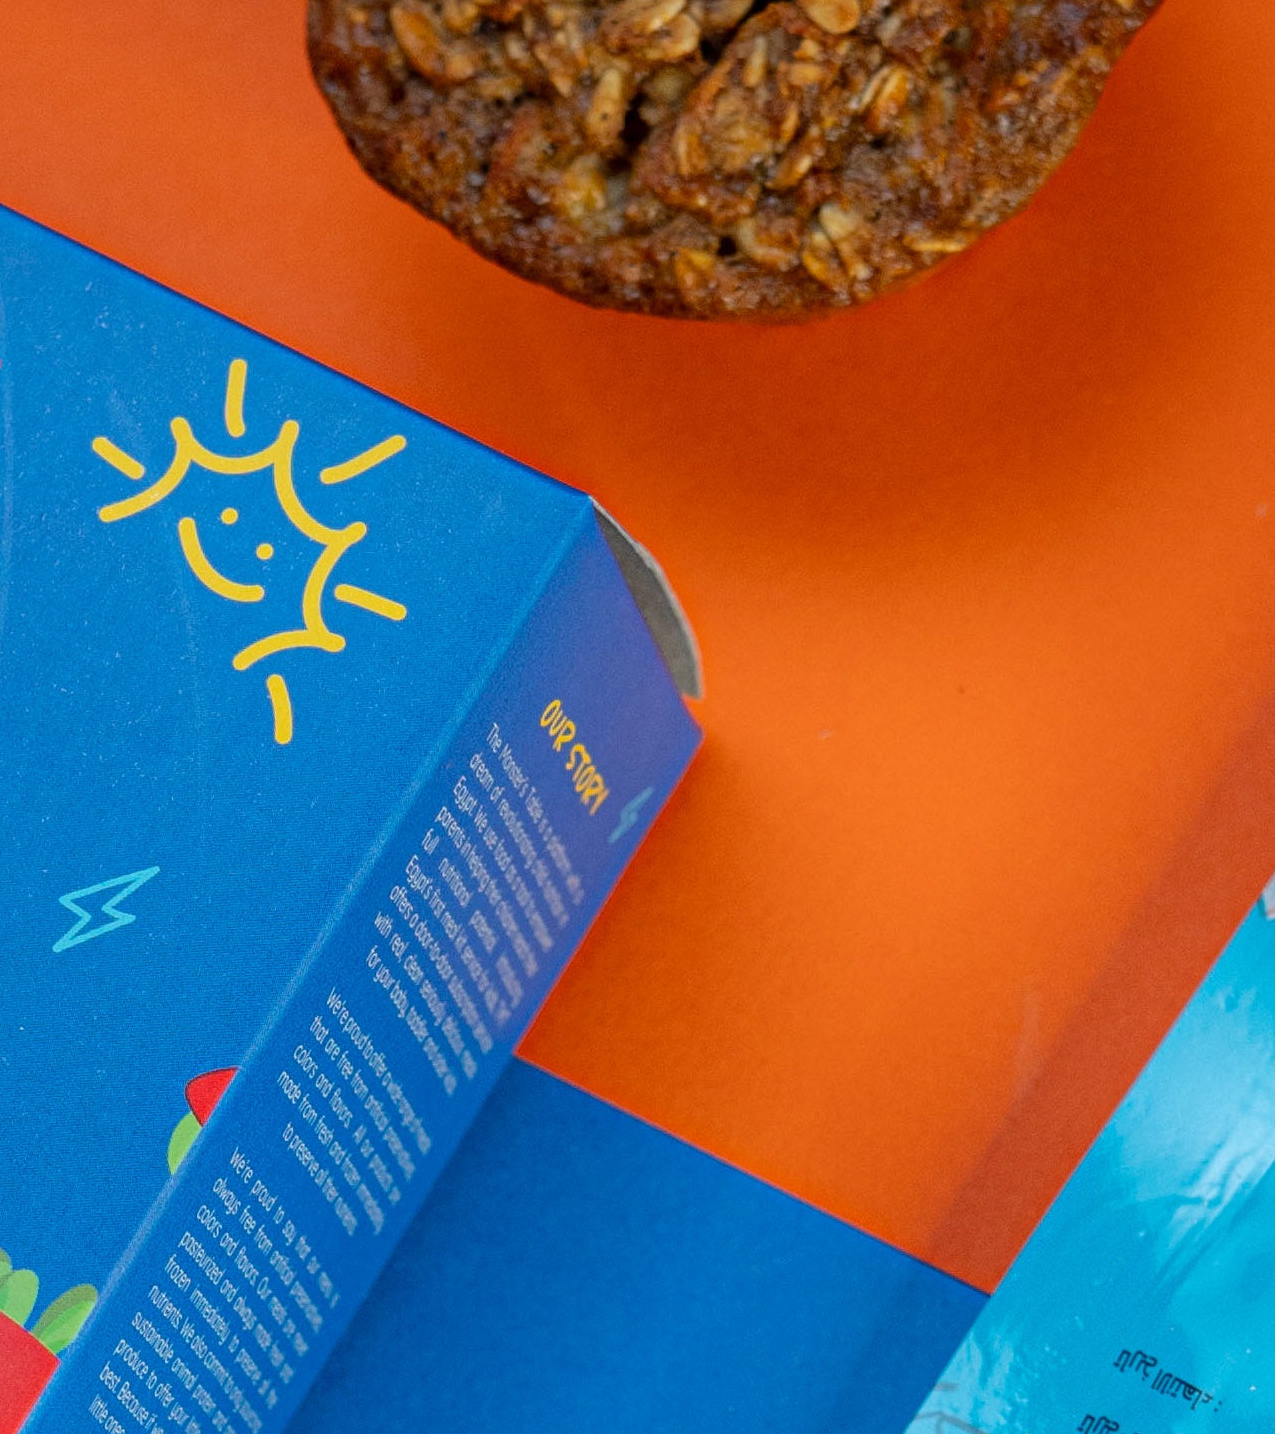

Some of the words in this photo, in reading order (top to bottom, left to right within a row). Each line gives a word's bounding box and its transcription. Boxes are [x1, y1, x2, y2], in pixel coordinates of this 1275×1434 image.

[539, 698, 576, 753] OUR
[468, 752, 494, 791] dream
[488, 785, 505, 803] of
[486, 721, 502, 753] The
[498, 743, 529, 797] Monster's
[421, 827, 440, 855] full
[434, 805, 466, 849] parents
[459, 840, 472, 856] in
[466, 846, 490, 893] helping
[473, 804, 488, 833] We
[493, 838, 512, 871] food
[388, 884, 414, 920] offers
[404, 853, 433, 900] Egypt's
[428, 887, 446, 918] first
[440, 910, 461, 940] meal
[408, 912, 419, 928] a
[365, 944, 381, 969] for
[372, 963, 394, 990] your
[373, 911, 392, 938] with
[389, 932, 407, 962] real,
[402, 954, 424, 984] clean
[413, 920, 454, 981] door-to-door
[325, 987, 349, 1025] We're
[388, 980, 408, 1018] baby,
[308, 1015, 329, 1044] that
[323, 1037, 340, 1061] are
[337, 1050, 354, 1080] free
[350, 1068, 369, 1098] from
[341, 1016, 369, 1050] proud
[361, 1039, 374, 1060] to
[292, 1043, 318, 1079] colors
[314, 1072, 334, 1098] and
[367, 1051, 387, 1077] offer
[277, 1070, 302, 1104] made
[298, 1092, 318, 1122] from
[316, 1114, 334, 1145] fresh
[281, 1121, 294, 1142] to
[288, 1134, 319, 1177] preserve
[211, 1177, 241, 1215] always
[238, 1204, 256, 1234] free
[253, 1223, 273, 1252] from
[229, 1146, 254, 1184] We're
[249, 1178, 277, 1212] proud
[272, 1204, 285, 1225] to
[281, 1218, 296, 1246] say
[177, 1230, 224, 1285] pasteurized
[218, 1278, 238, 1303] and
[232, 1295, 257, 1330] always
[195, 1203, 223, 1238] colors
[218, 1231, 239, 1257] and
[255, 1275, 272, 1300] Our
[148, 1284, 183, 1329] nutrients.
[179, 1316, 195, 1343] We
[189, 1334, 208, 1359] also
[164, 1253, 191, 1291] frozen
[189, 1288, 230, 1345] immediately
[227, 1334, 240, 1353] to
[130, 1311, 174, 1363] sustainable
[170, 1356, 198, 1390] animal
[1113, 1350, 1158, 1382] تاريخ
[88, 1395, 109, 1424] little
[98, 1360, 121, 1393] best.
[116, 1380, 149, 1425] Because
[144, 1412, 157, 1428] if
[112, 1338, 149, 1379] produce
[144, 1369, 158, 1390] to
[153, 1382, 175, 1407] offer
[166, 1403, 189, 1425] your
